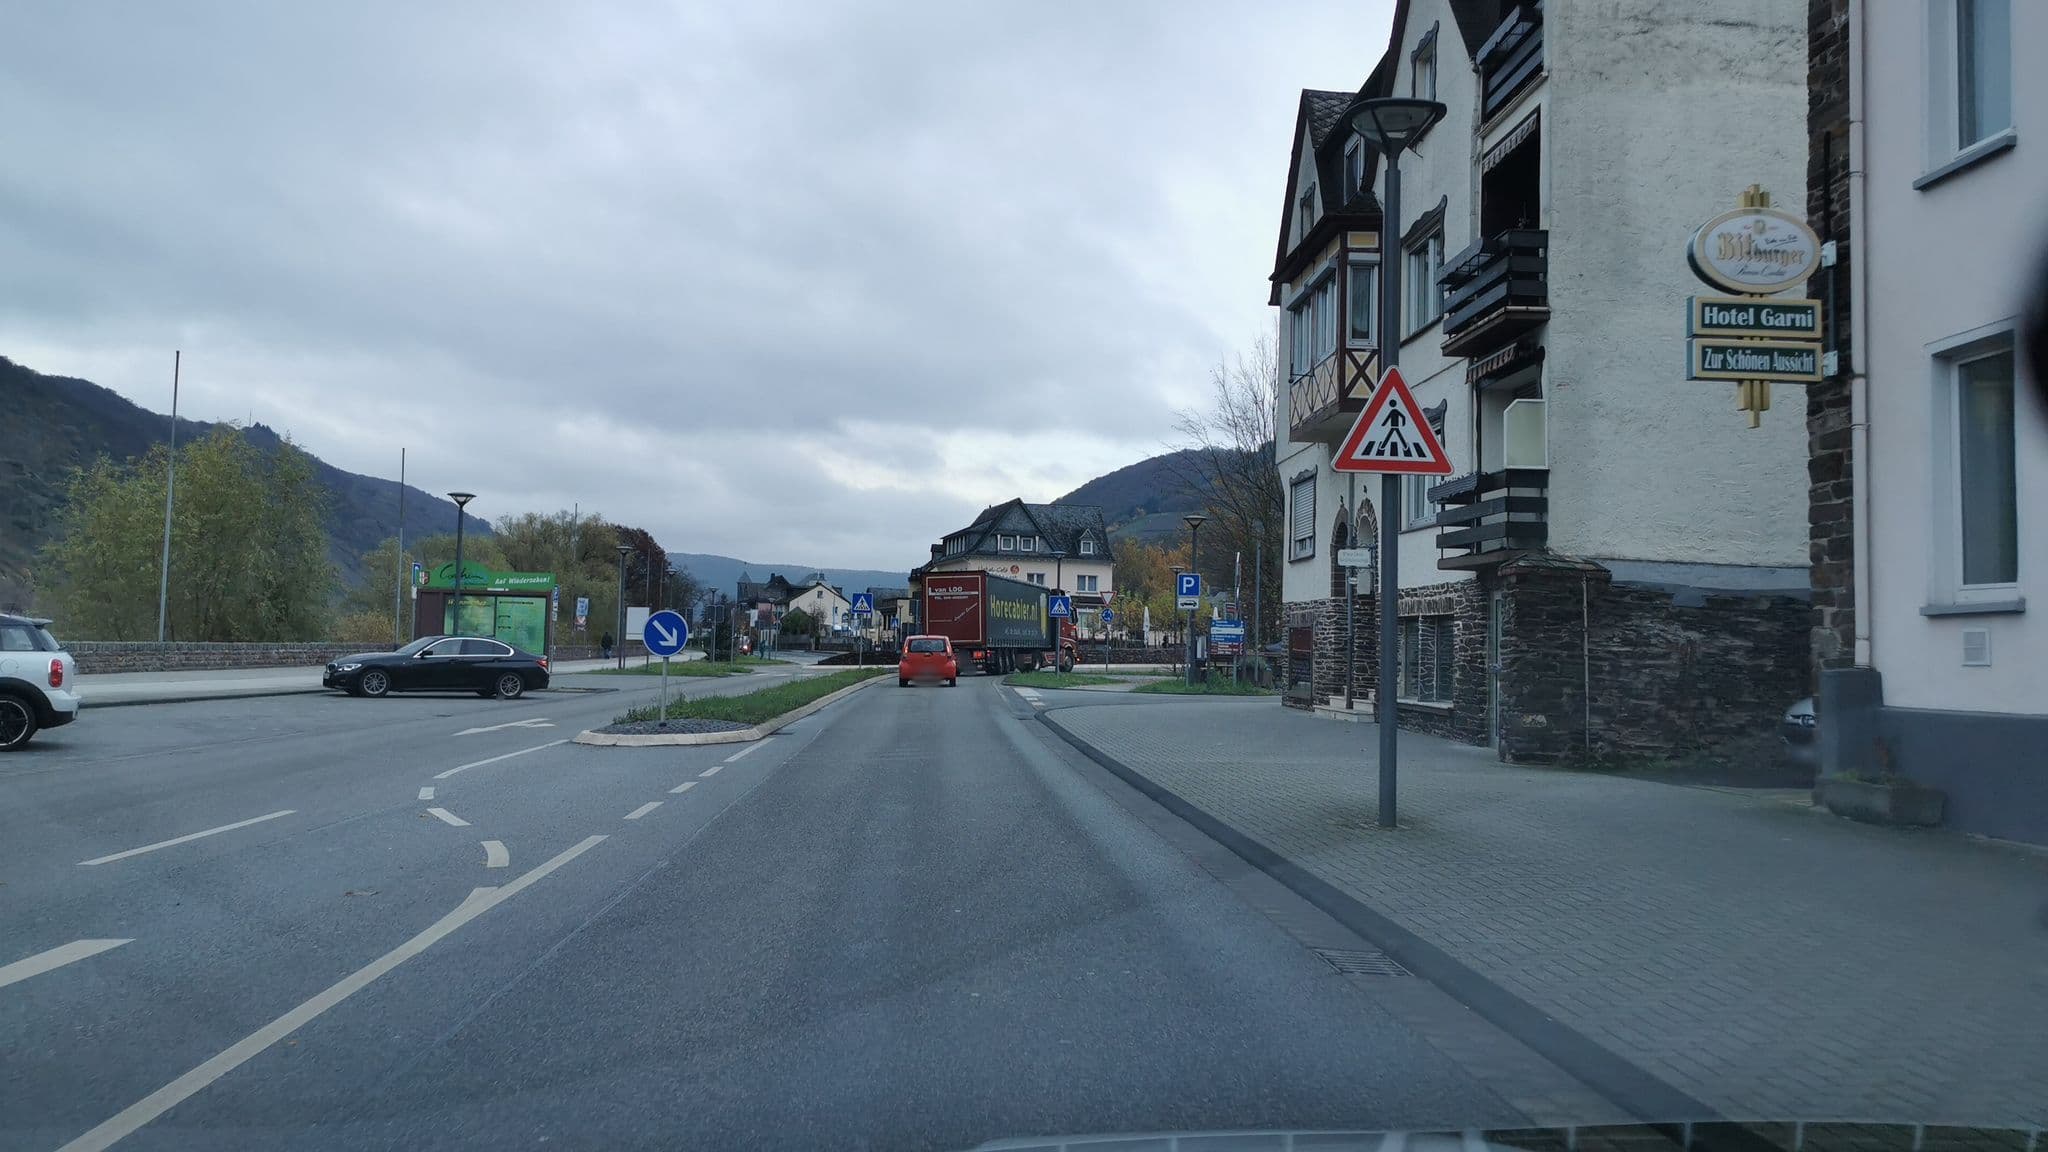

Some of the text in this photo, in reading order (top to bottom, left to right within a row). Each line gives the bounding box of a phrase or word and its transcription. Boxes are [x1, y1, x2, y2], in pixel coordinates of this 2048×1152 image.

[1717, 232, 1806, 266] Bitburger
[1704, 306, 1813, 328] Hotel Garni
[1704, 348, 1814, 372] Zur Schönen Aussicht
[1183, 576, 1195, 594] P
